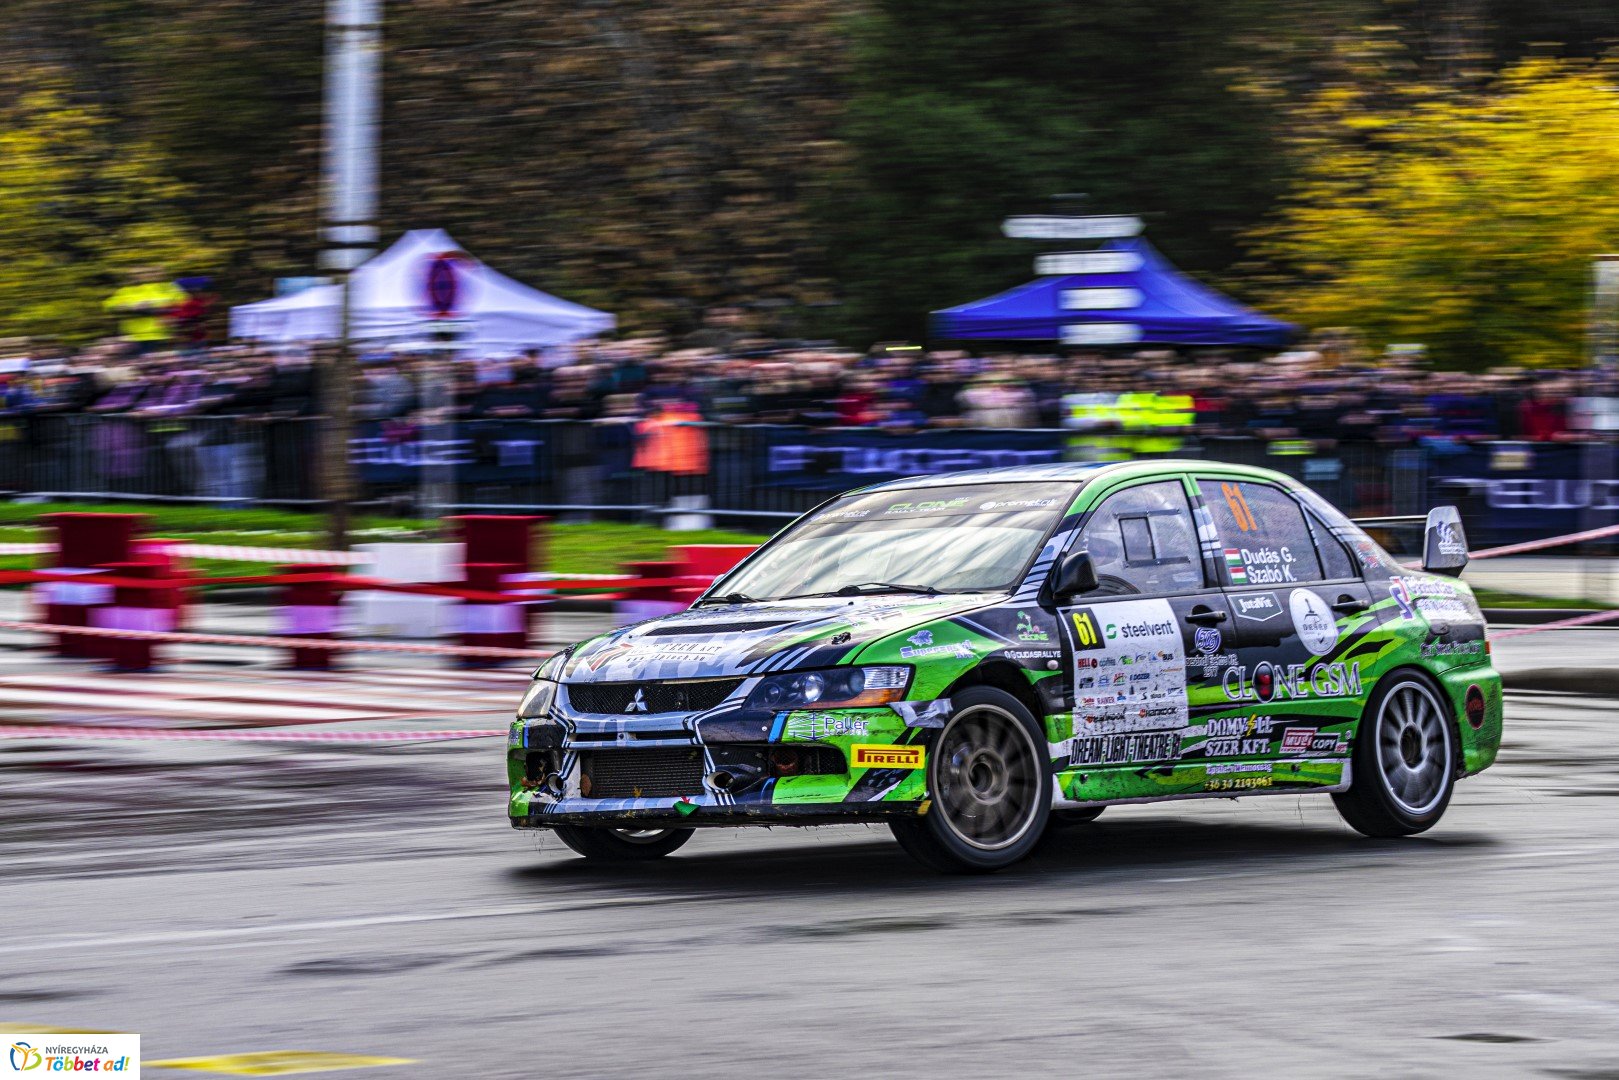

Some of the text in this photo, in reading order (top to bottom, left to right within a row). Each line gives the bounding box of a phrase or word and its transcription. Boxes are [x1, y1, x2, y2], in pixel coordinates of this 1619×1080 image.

[888, 499, 967, 511] CLONE
[1220, 482, 1258, 532] 61
[1241, 546, 1297, 565] Dudás G.
[1246, 564, 1298, 584] Szabó K.
[1072, 612, 1098, 646] 61
[1121, 620, 1175, 638] steelvent
[1222, 661, 1363, 704] CLONE GSM
[825, 717, 869, 731] Pallér
[1204, 737, 1272, 757] SZER KFT.
[1312, 738, 1336, 750] COPY
[857, 748, 919, 764] PIRELLI
